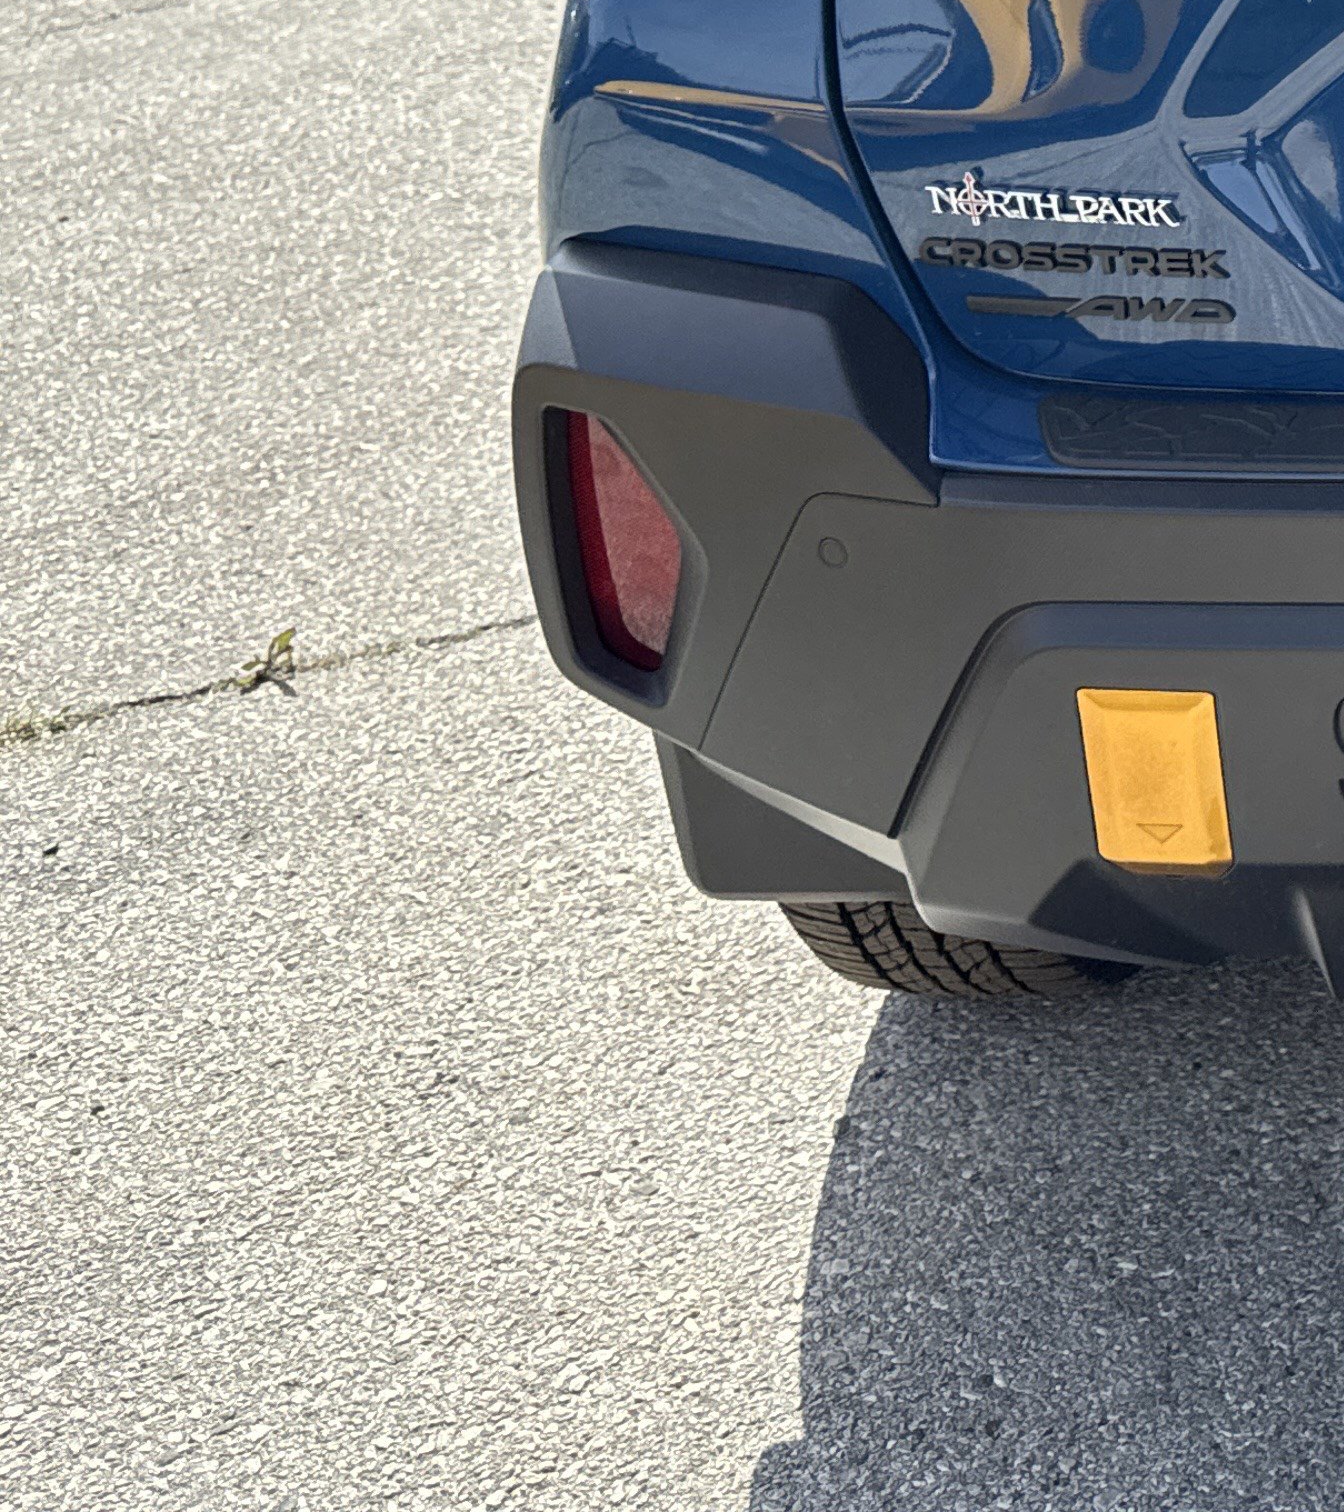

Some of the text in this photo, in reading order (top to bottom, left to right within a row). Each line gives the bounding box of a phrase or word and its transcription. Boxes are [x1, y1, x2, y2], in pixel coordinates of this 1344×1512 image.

[925, 172, 1181, 228] NORTH PARK
[918, 236, 1232, 279] CROSSTREK
[1065, 295, 1237, 324] AWD
